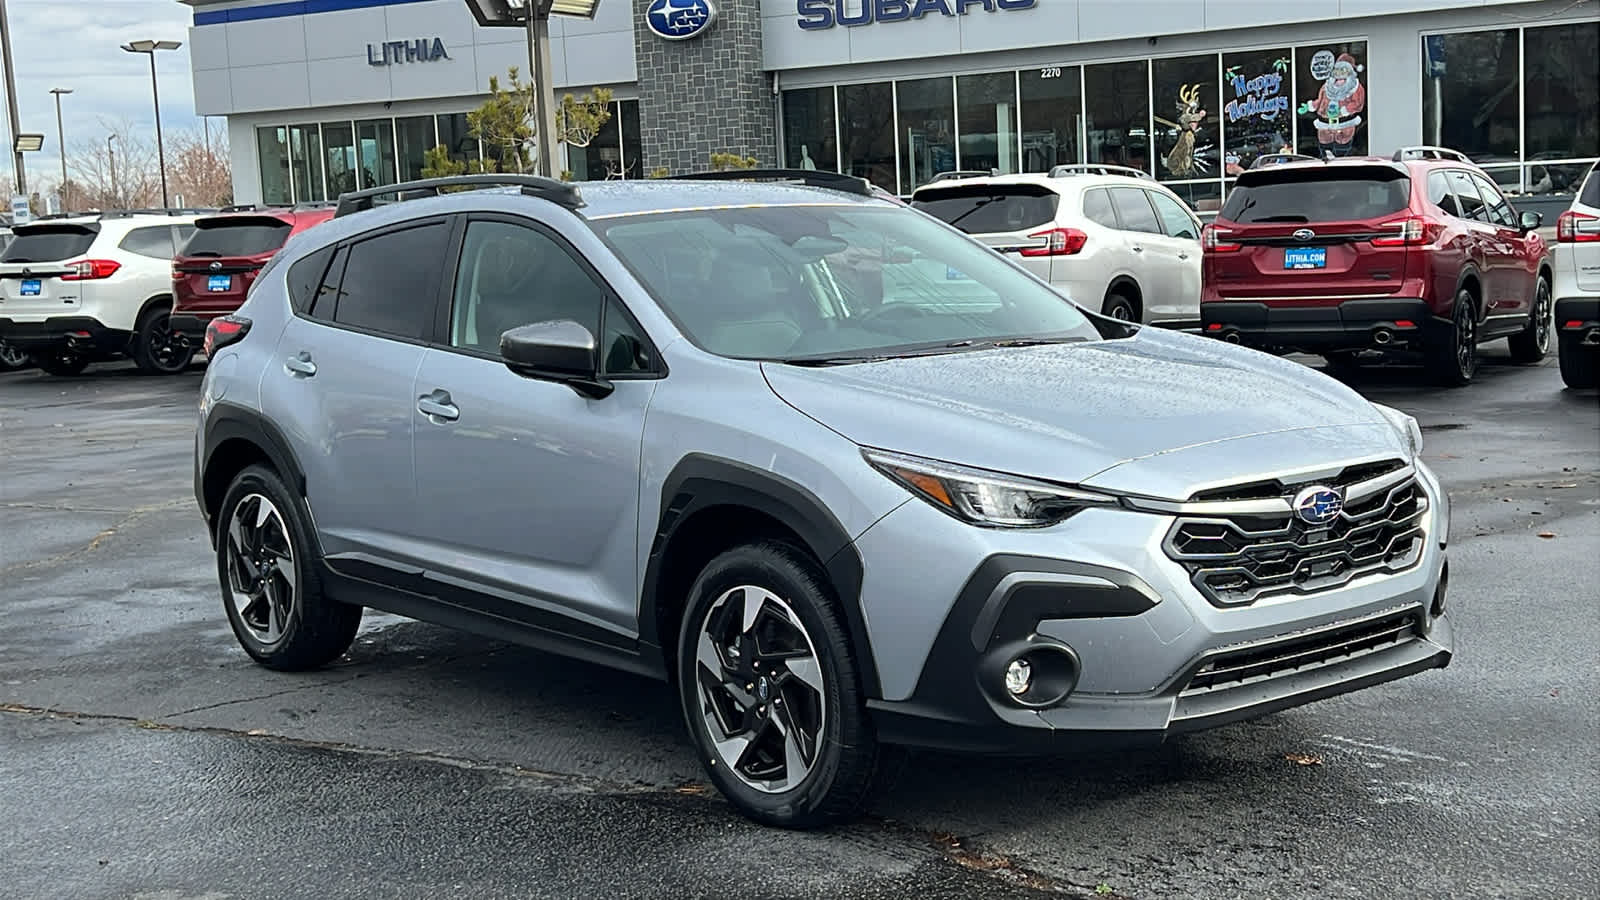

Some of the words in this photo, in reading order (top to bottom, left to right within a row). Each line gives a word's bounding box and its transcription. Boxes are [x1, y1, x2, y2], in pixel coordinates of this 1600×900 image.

[797, 0, 1037, 30] SUBA
[367, 37, 449, 66] LITHIA
[1041, 67, 1061, 79] 2270
[1230, 72, 1282, 97] Happy
[1224, 93, 1288, 123] Holidays
